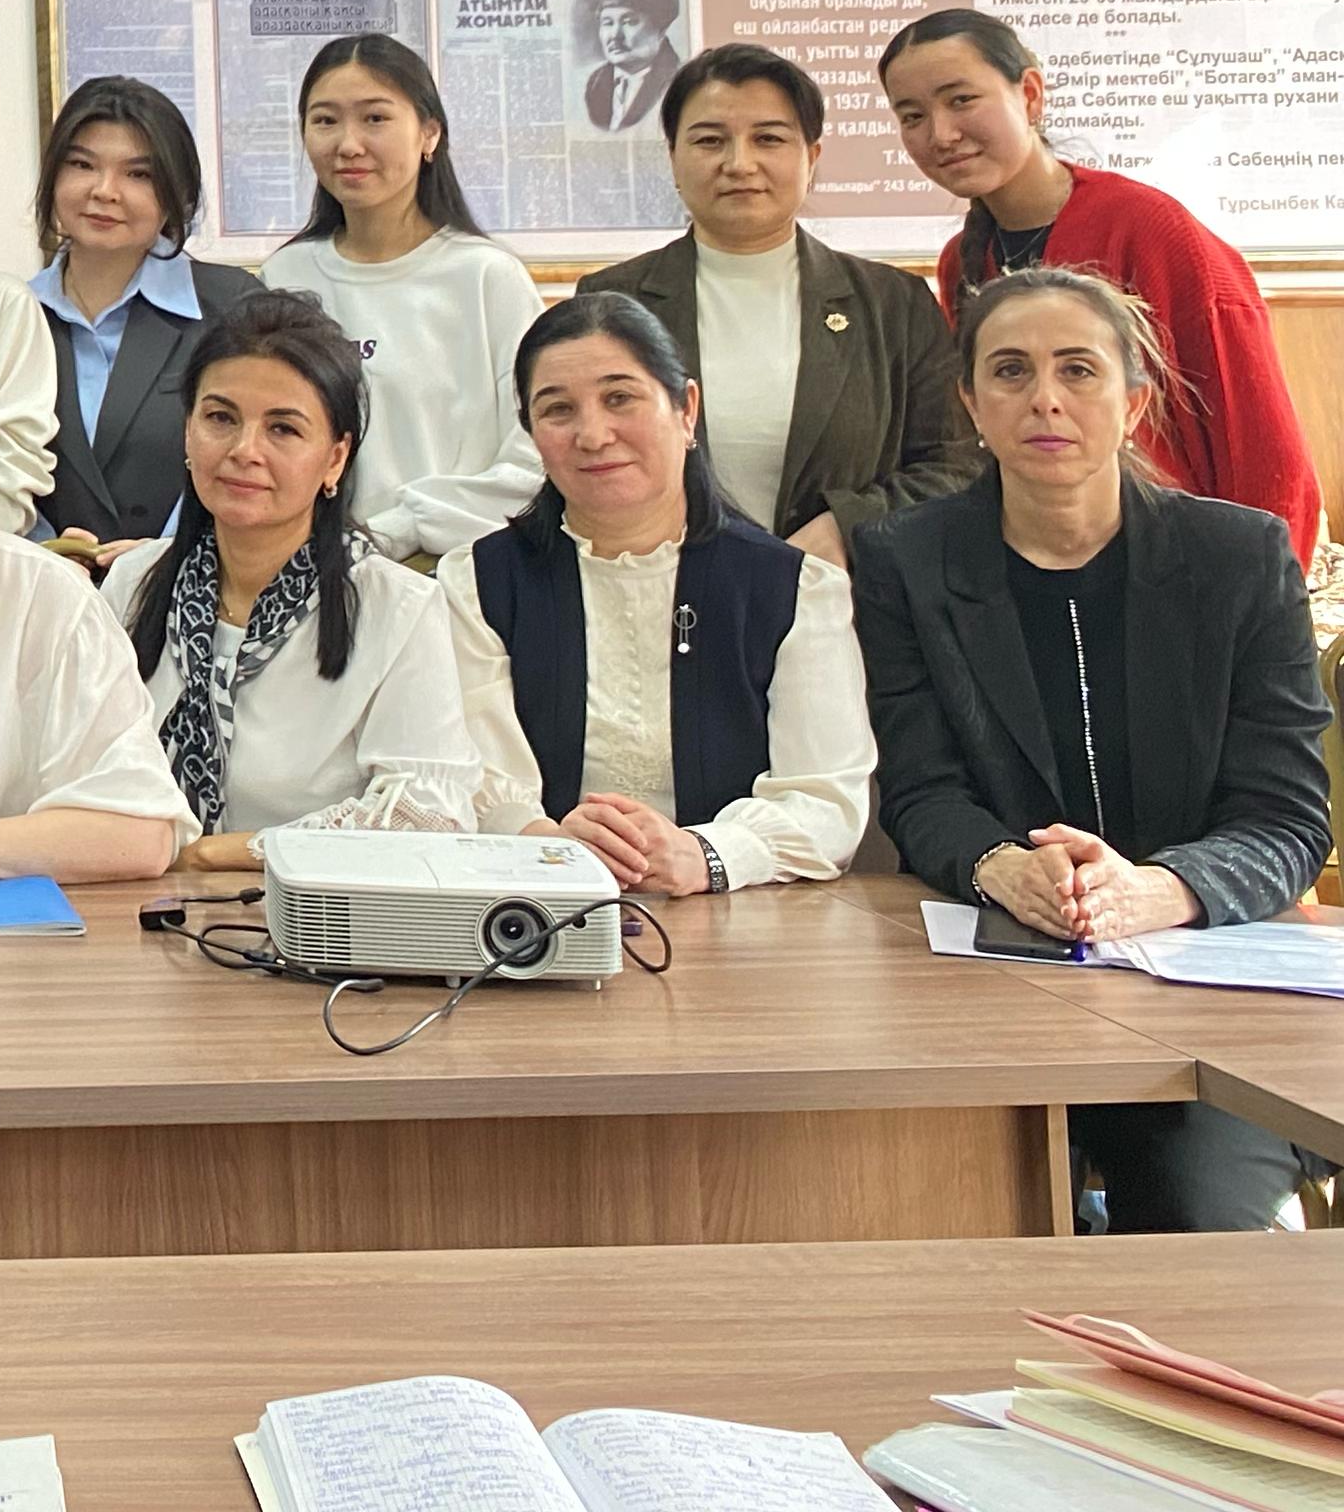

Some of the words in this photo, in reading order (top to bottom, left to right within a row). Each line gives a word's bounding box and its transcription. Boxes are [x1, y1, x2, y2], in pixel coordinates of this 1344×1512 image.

[456, 14, 552, 29] ЖОМАРТЫ
[734, 21, 757, 35] еш
[762, 17, 864, 35] ойланбастан
[1029, 13, 1072, 26] десе
[1076, 12, 1099, 27] де
[1105, 10, 1182, 26] болады.
[1049, 51, 1160, 67] әдебиетінде
[834, 94, 870, 109] 1937
[1082, 93, 1157, 107] Сәбитке
[1163, 94, 1189, 106] еш
[1194, 93, 1268, 109] уақытта
[1274, 92, 1339, 107] рухани
[1228, 152, 1312, 168] Сәбеңнің
[884, 181, 905, 192] 243
[1218, 196, 1320, 214] Тұрсынбек
